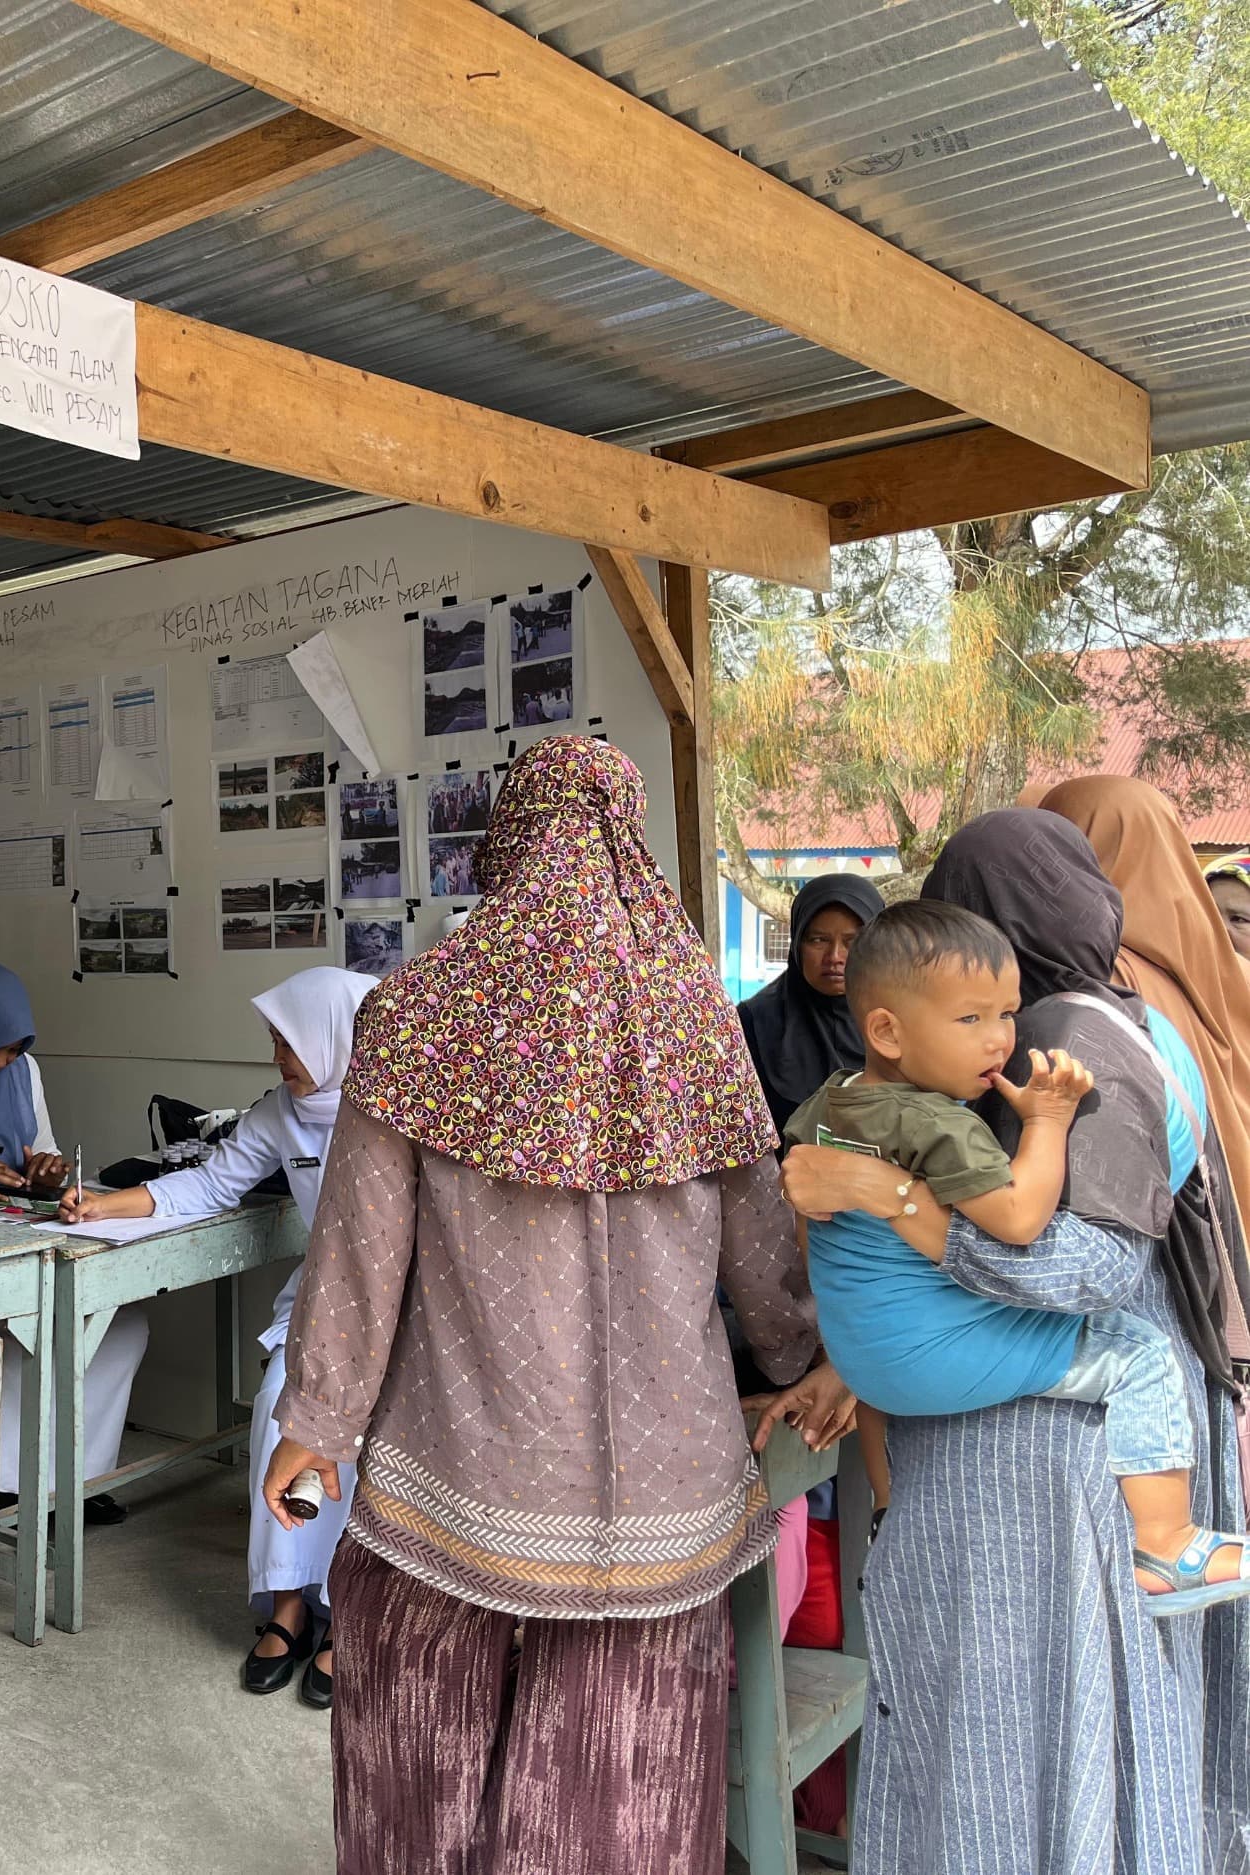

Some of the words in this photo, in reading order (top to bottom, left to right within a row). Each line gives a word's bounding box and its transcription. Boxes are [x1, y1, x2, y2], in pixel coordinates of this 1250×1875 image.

[69, 350, 118, 386] ALAM
[22, 381, 55, 418] WIH
[65, 391, 123, 441] PESAM
[3, 599, 56, 628] PESAM
[161, 587, 270, 644] KEGIATAN
[276, 556, 401, 612] TAGANA
[190, 628, 233, 653] DINAS
[241, 616, 300, 641] SOSIAL
[397, 570, 460, 606] MERIAH
